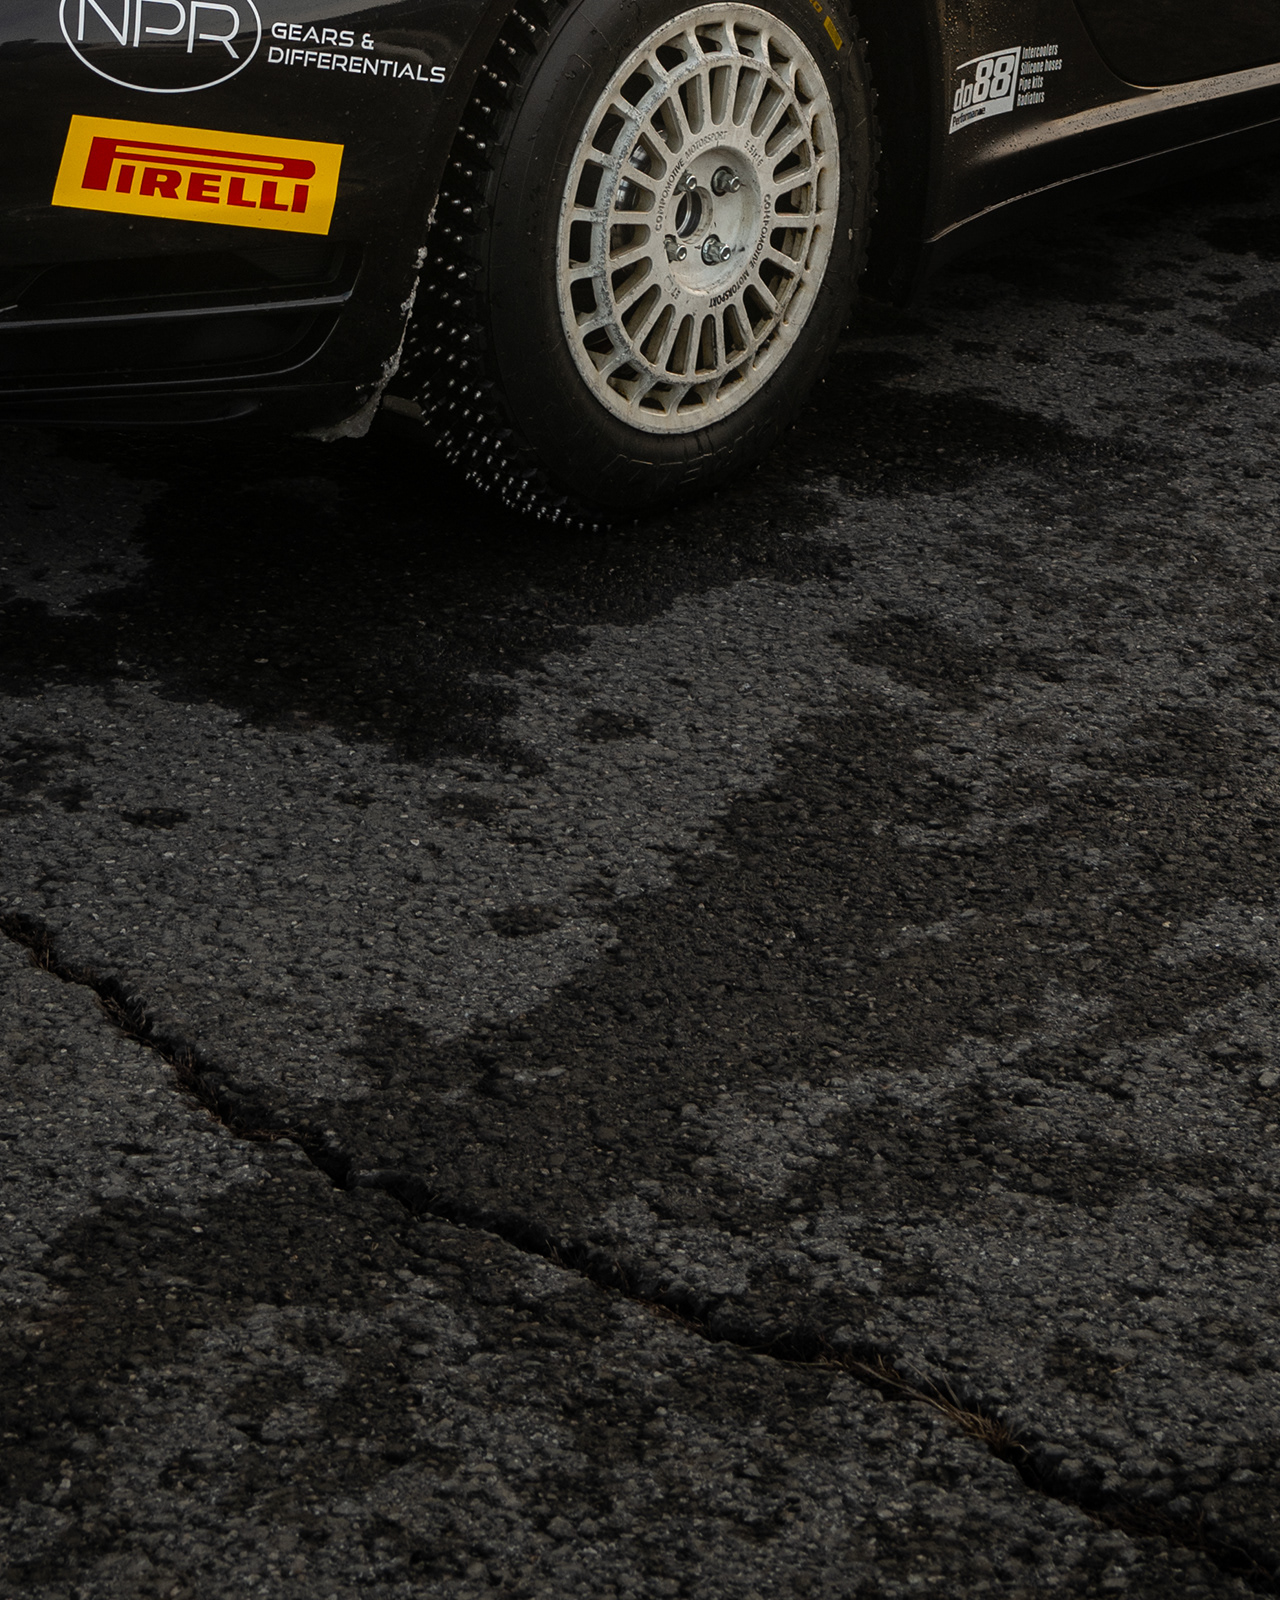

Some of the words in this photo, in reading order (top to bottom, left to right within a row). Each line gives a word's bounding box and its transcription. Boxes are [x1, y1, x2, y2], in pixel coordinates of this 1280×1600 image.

[271, 21, 355, 48] GEARS
[361, 32, 375, 50] &
[267, 46, 447, 84] DIFFERENTIALS
[1044, 58, 1063, 72] hoses
[953, 54, 1016, 112] do88
[1018, 77, 1032, 92] Pipe
[1032, 75, 1044, 89] kits
[952, 106, 986, 128] Performance
[81, 136, 316, 214] PIRELLI
[708, 270, 750, 308] MOTORSPORT
